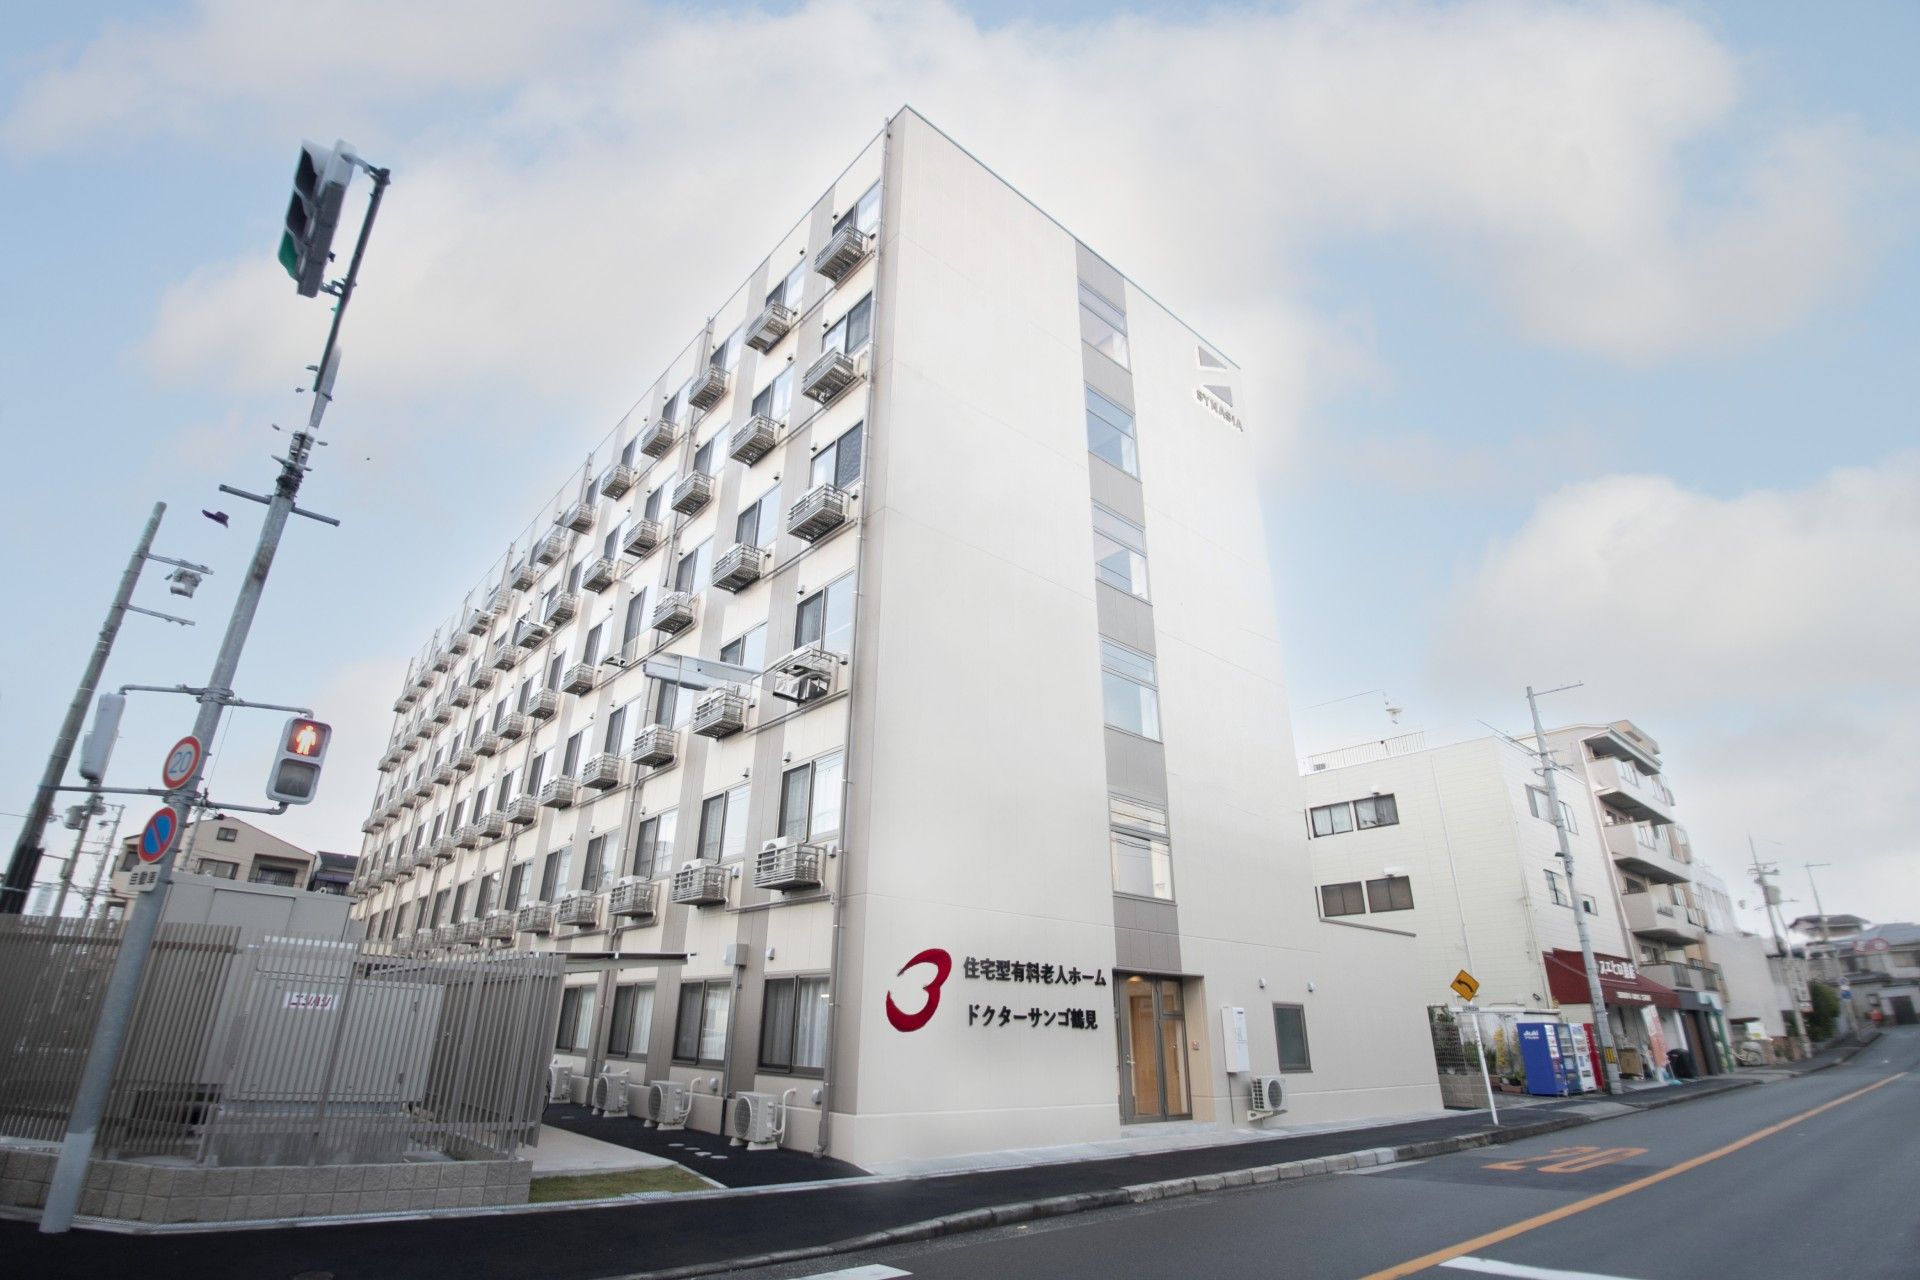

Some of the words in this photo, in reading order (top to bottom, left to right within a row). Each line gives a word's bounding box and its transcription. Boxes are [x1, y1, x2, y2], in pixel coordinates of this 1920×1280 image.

[168, 751, 193, 774] 20
[963, 956, 1107, 987] 住宅型有料老人ホーム
[968, 1004, 1098, 1030] ドクターサンゴ鶴見
